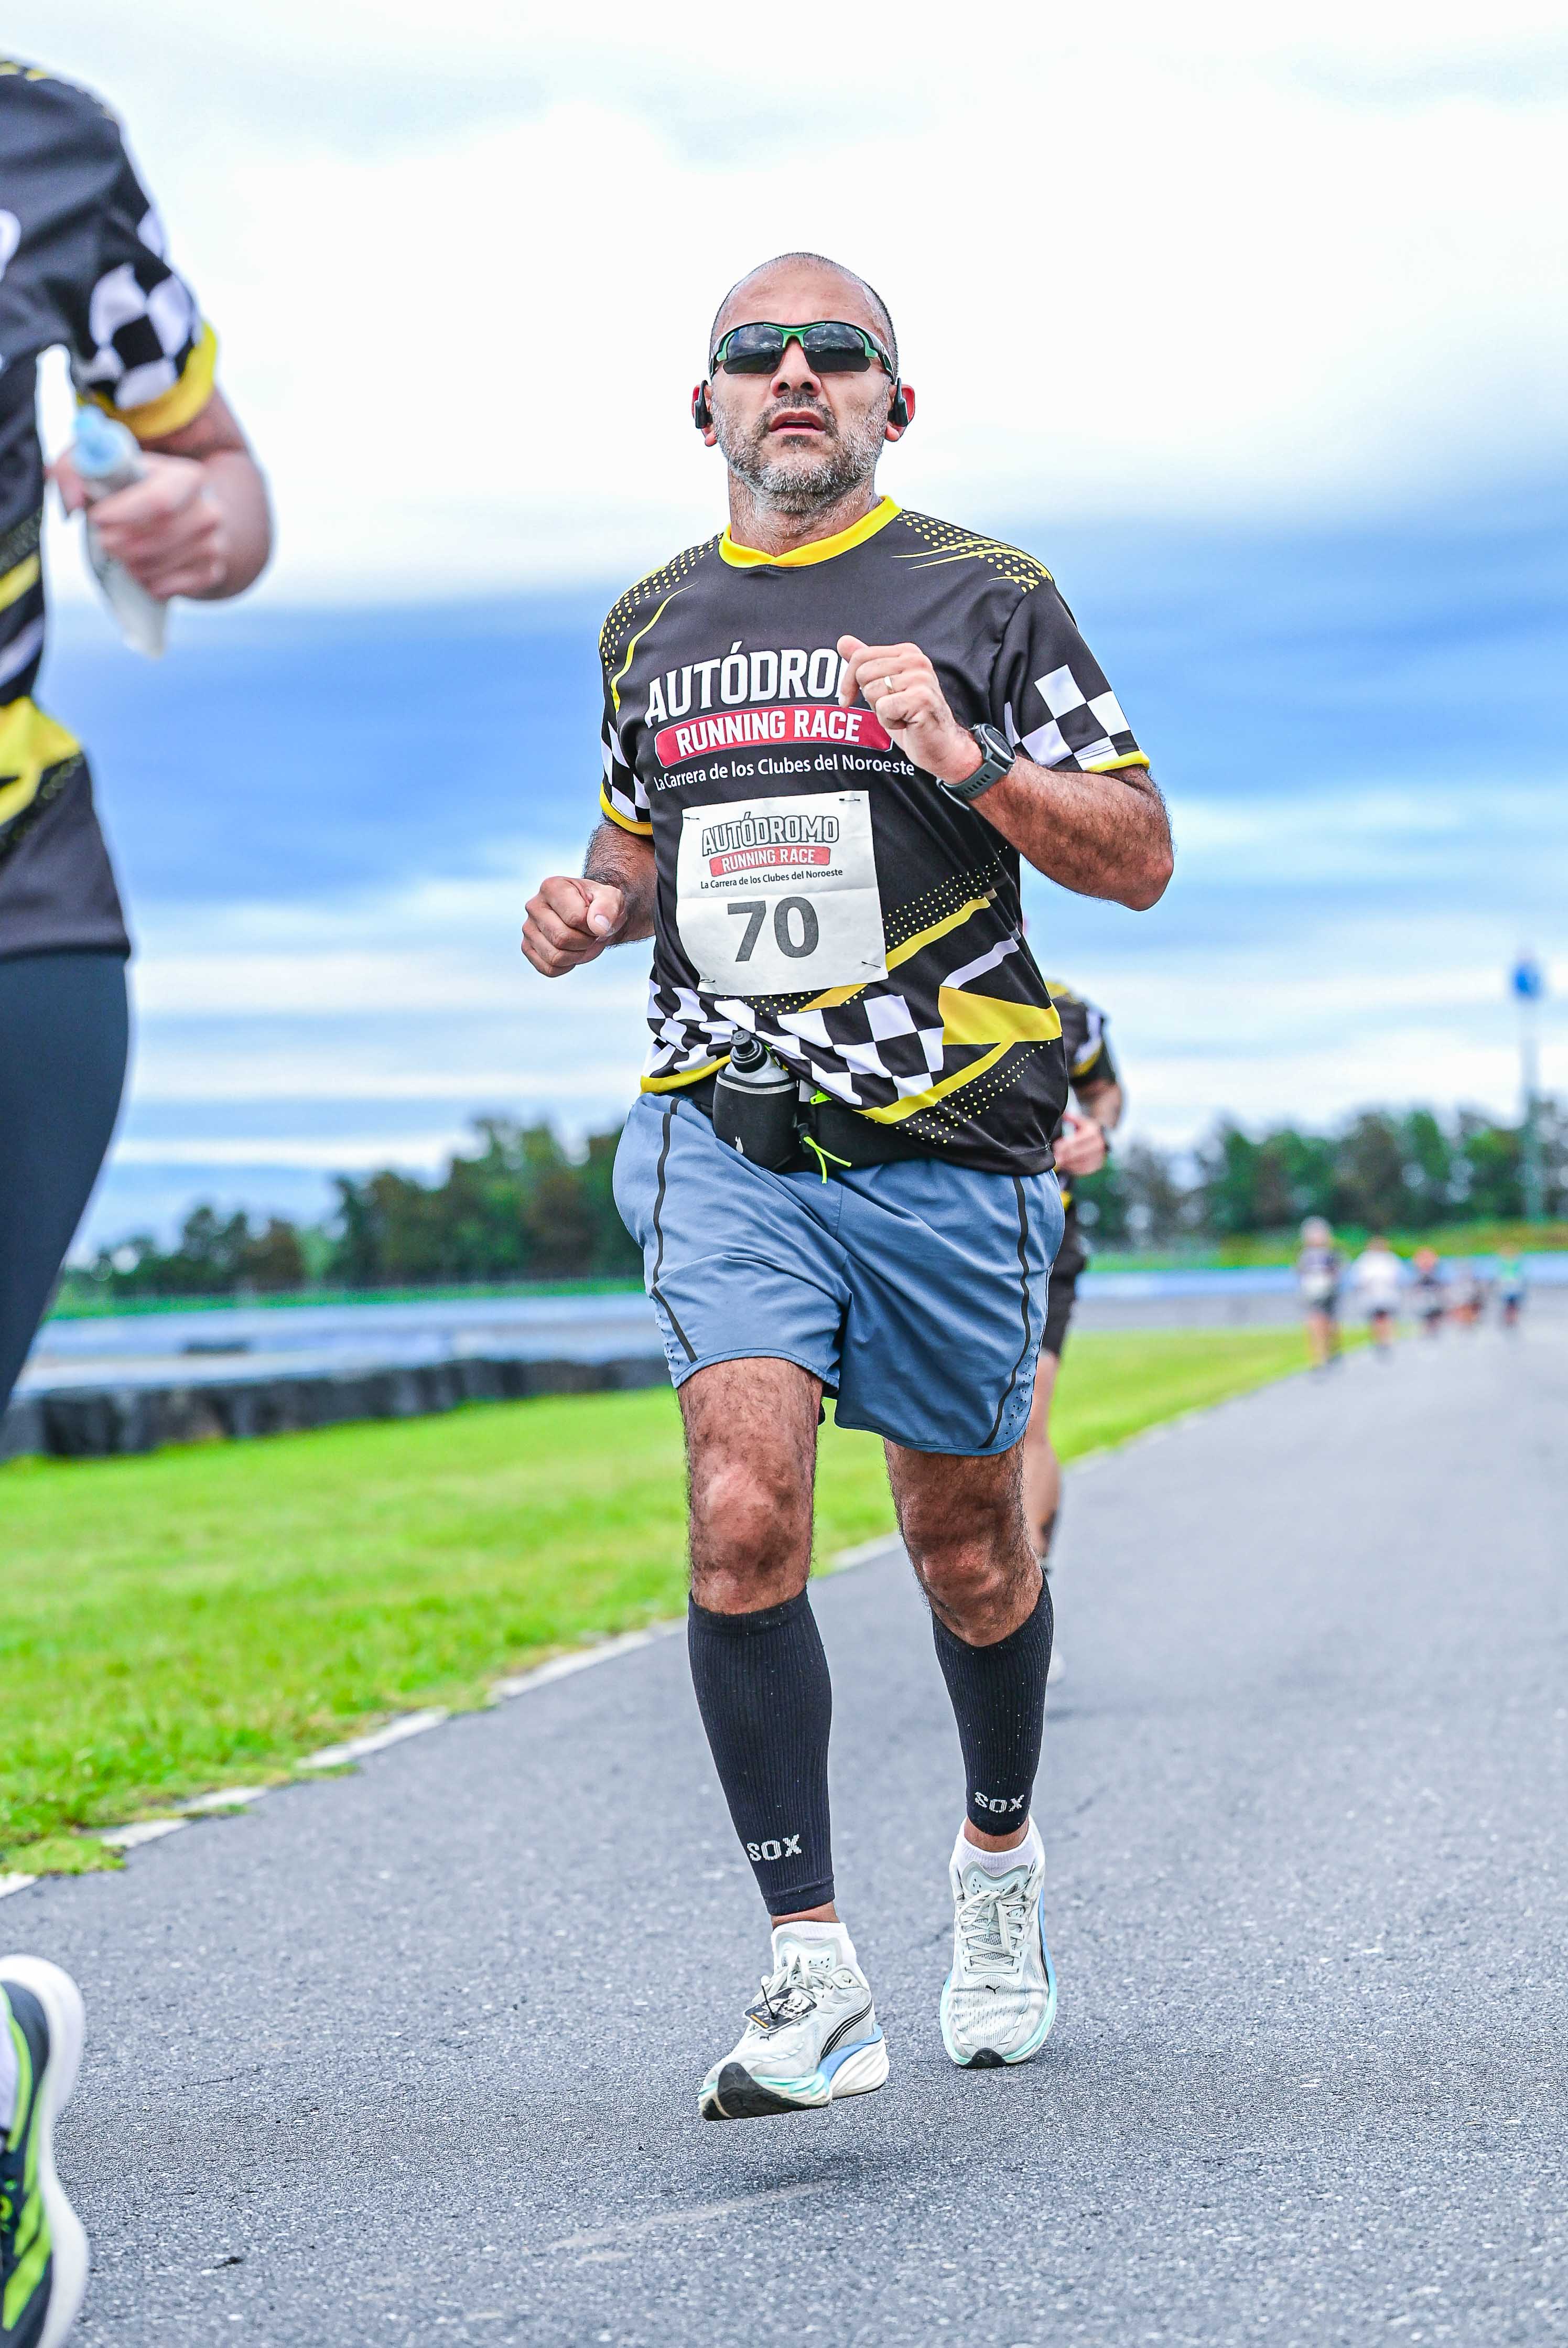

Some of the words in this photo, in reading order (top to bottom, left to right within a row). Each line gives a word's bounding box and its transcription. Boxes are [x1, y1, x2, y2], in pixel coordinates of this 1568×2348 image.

[644, 641, 849, 728] AUTÓDRO
[675, 711, 786, 757] RUNNING
[793, 709, 863, 743] RACE
[654, 776, 665, 791] La
[663, 770, 706, 789] Carrera
[710, 762, 728, 780] de
[731, 761, 753, 777] los
[758, 758, 811, 776] Clubes
[814, 755, 838, 772] del
[842, 755, 915, 777] Noroeste
[702, 811, 839, 856] AUTÓDROMO
[700, 881, 709, 889] La
[710, 879, 737, 888] Carrera
[739, 876, 748, 885] de
[750, 875, 761, 884] los
[763, 873, 790, 883] Clubes
[791, 870, 804, 880] del
[806, 868, 843, 878] Noroeste
[721, 849, 776, 873] RUNNING
[780, 848, 815, 864] RACE
[728, 896, 819, 962] 70
[974, 1791, 1025, 1813] SOX
[747, 1834, 802, 1861] SOX
